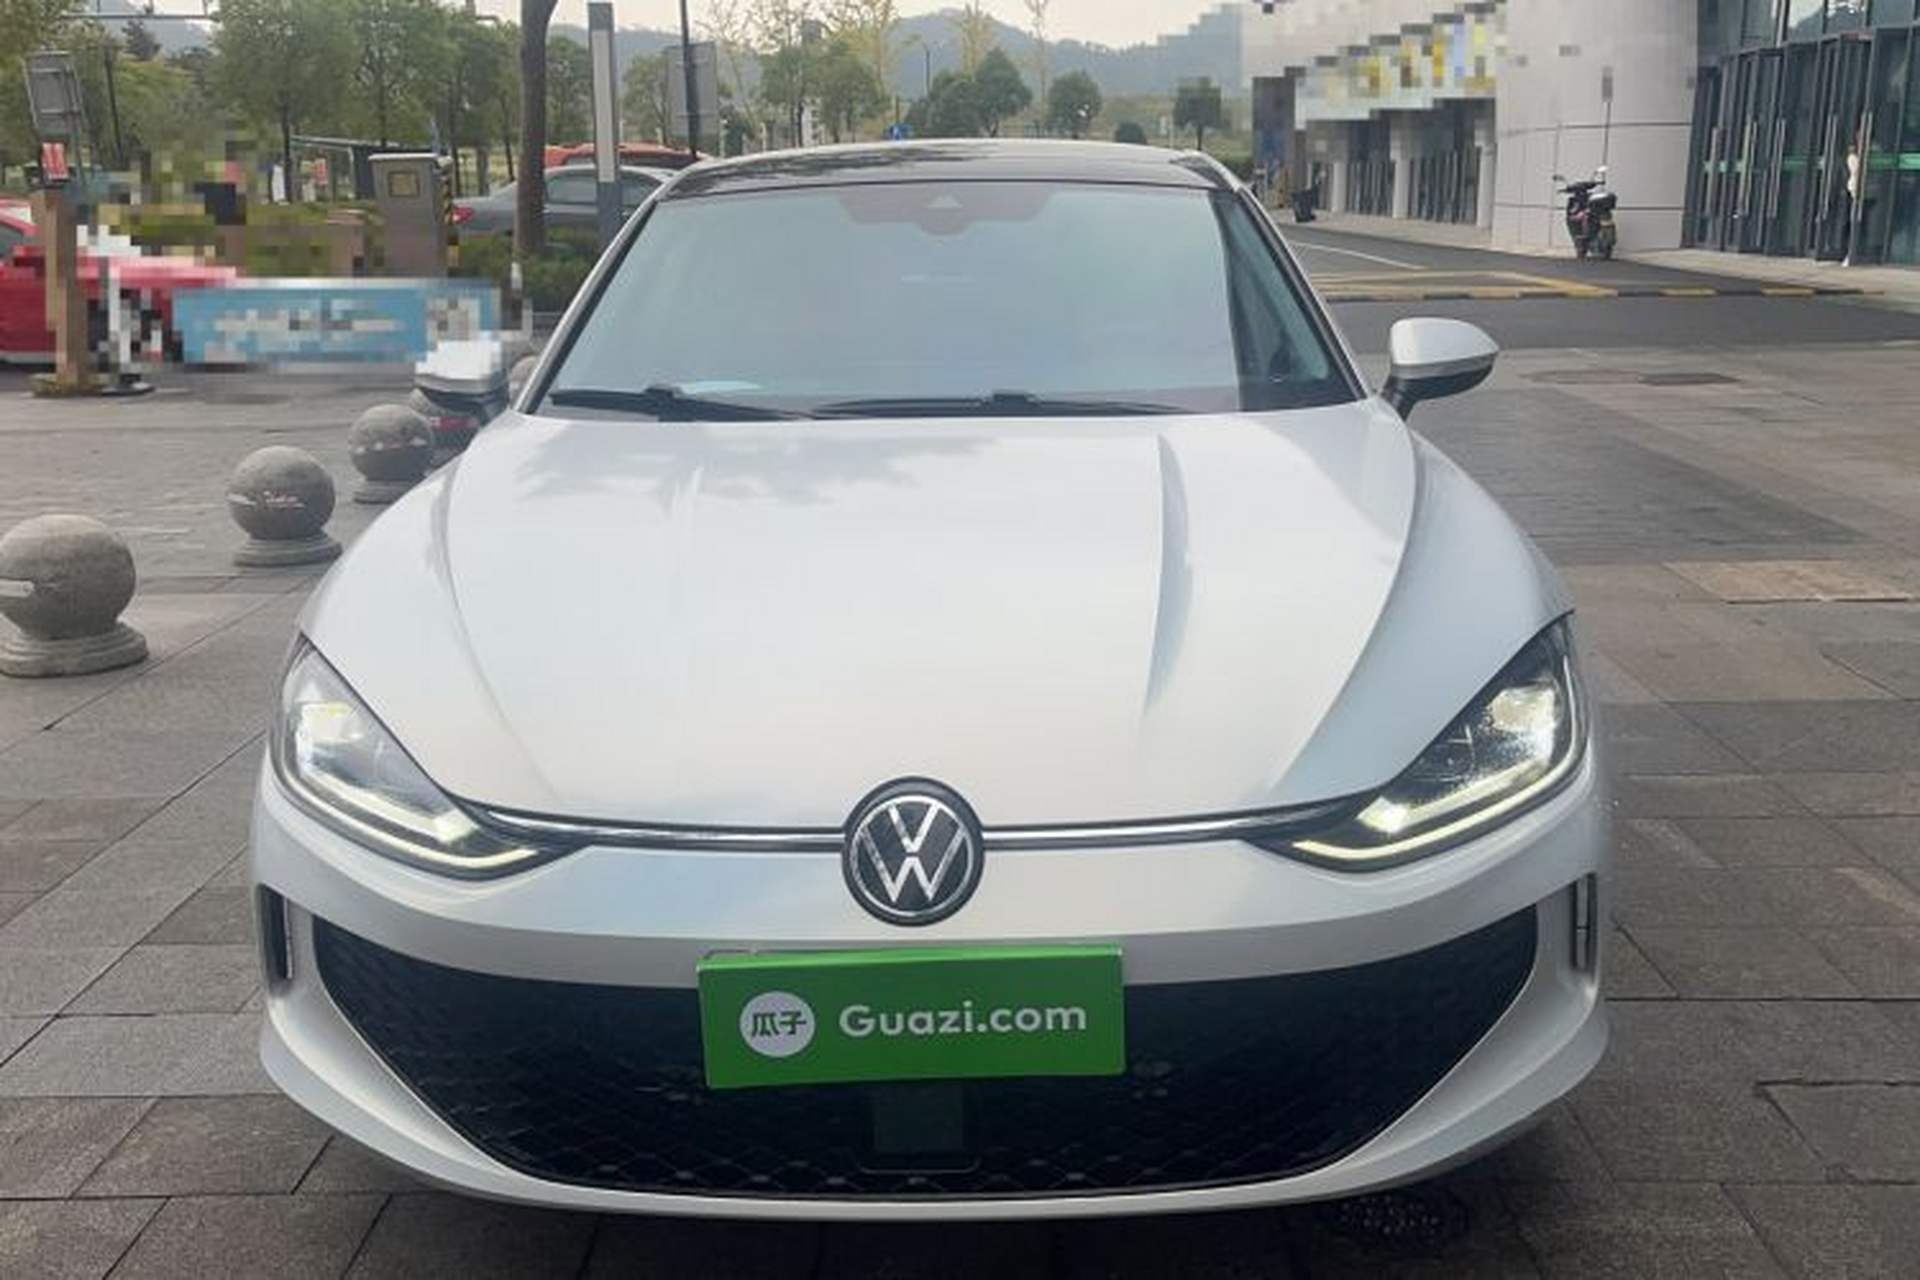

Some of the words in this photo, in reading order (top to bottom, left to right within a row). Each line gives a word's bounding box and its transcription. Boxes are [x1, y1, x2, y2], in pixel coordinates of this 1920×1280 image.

[855, 799, 970, 906] VW
[751, 1010, 807, 1037] 瓜子
[839, 1000, 1087, 1037] Guazi.com
